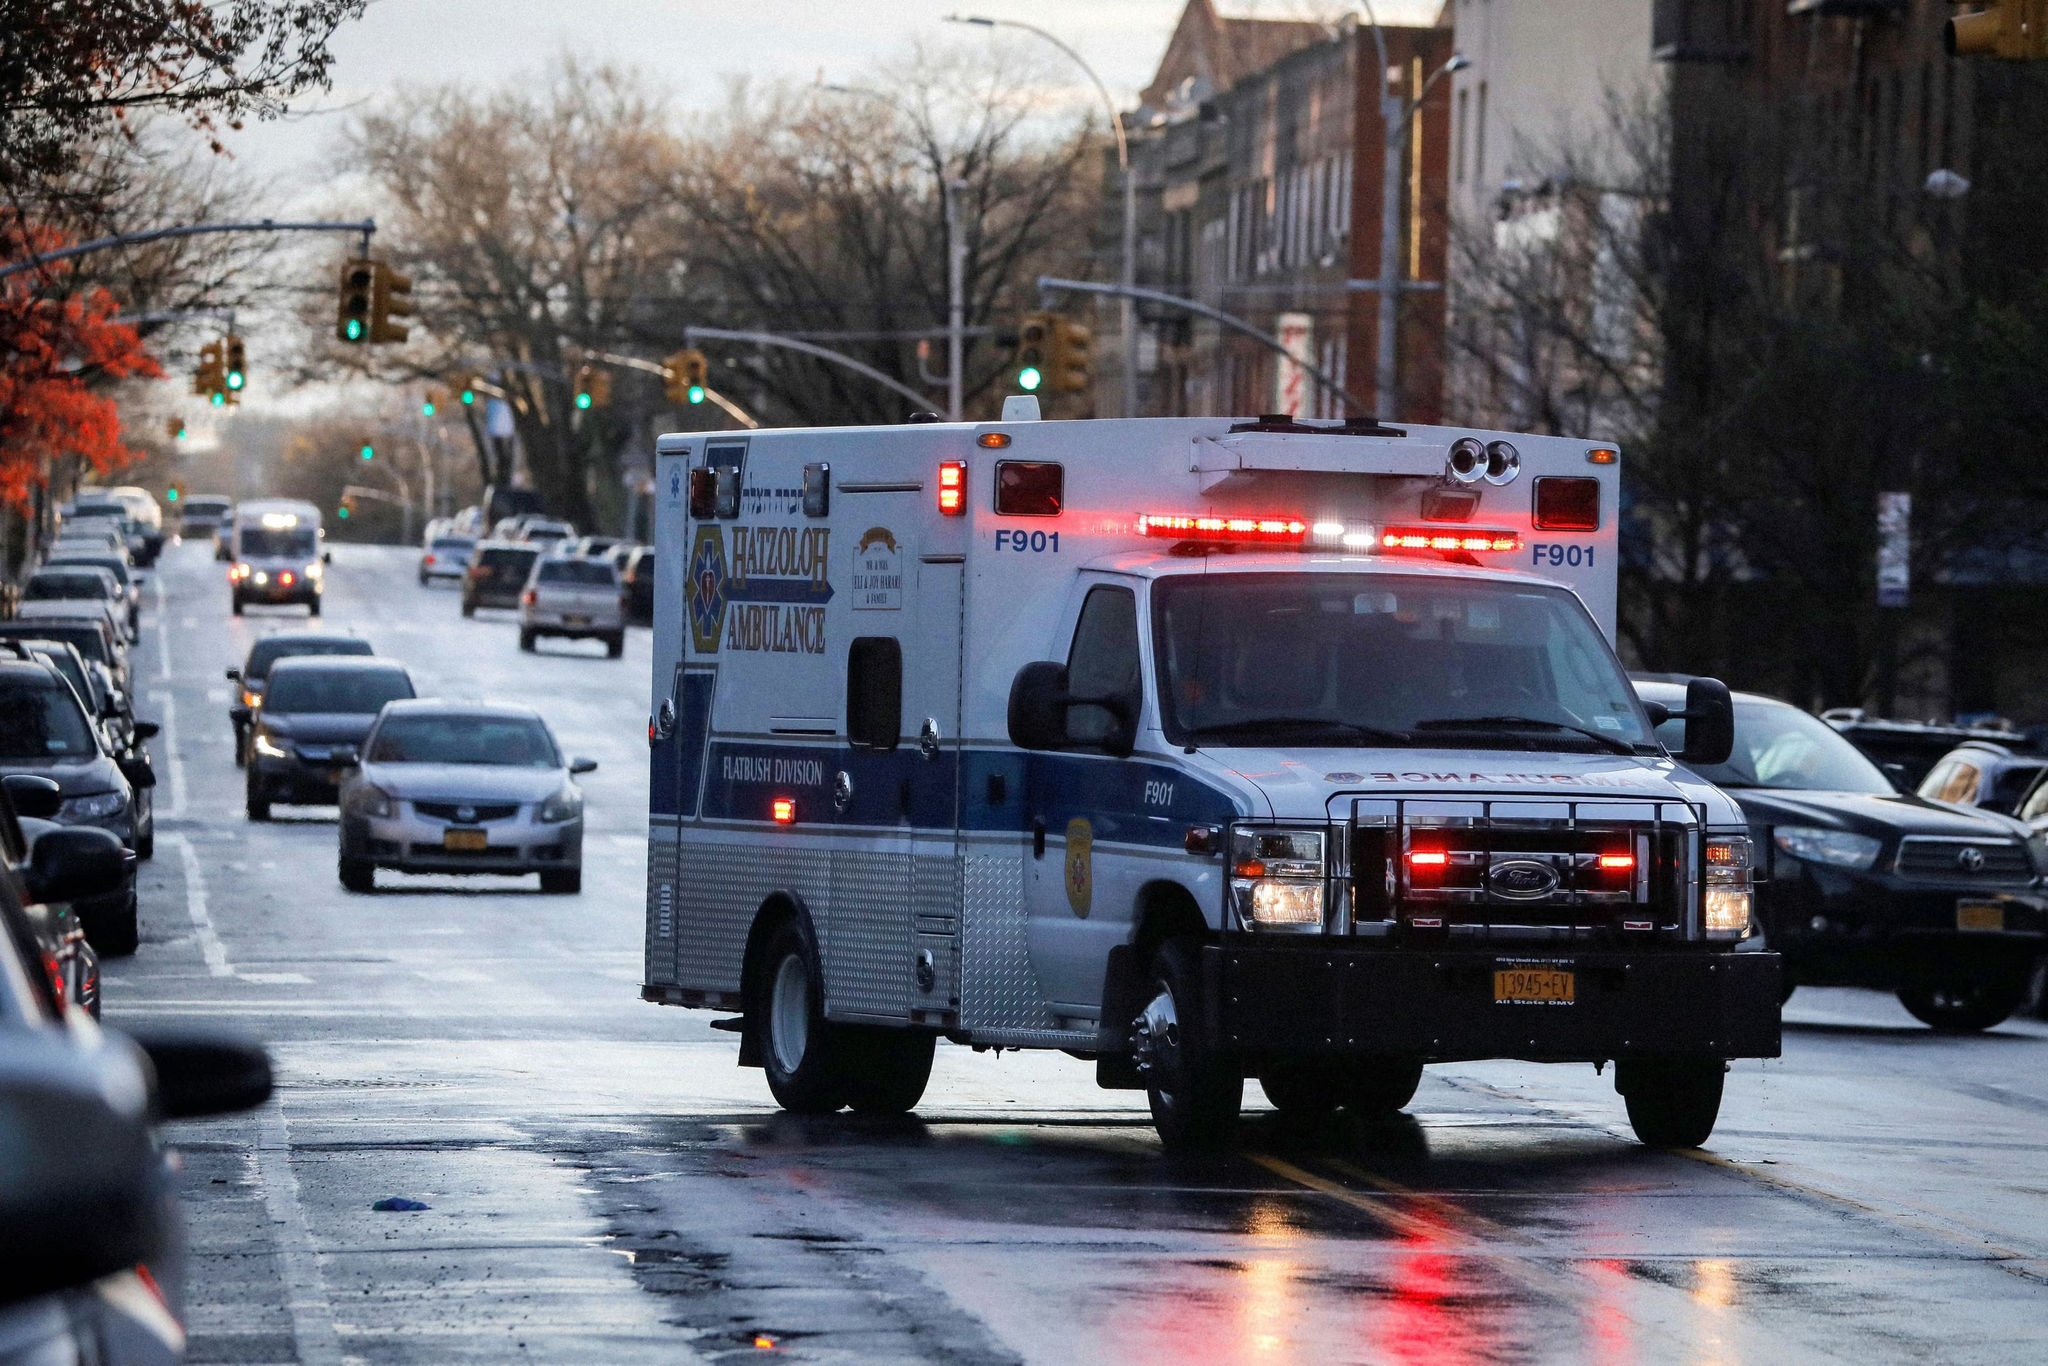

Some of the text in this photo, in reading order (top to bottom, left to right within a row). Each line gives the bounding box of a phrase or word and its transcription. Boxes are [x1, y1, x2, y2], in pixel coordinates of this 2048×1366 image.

[995, 529, 1059, 553] F901
[731, 526, 831, 592] HATZOLOH
[1532, 543, 1594, 568] F901
[869, 575, 879, 590] JOY
[726, 604, 826, 654] AMBULANCE
[723, 756, 823, 786] FLATBUSH DIVISION
[1144, 780, 1174, 806] F901
